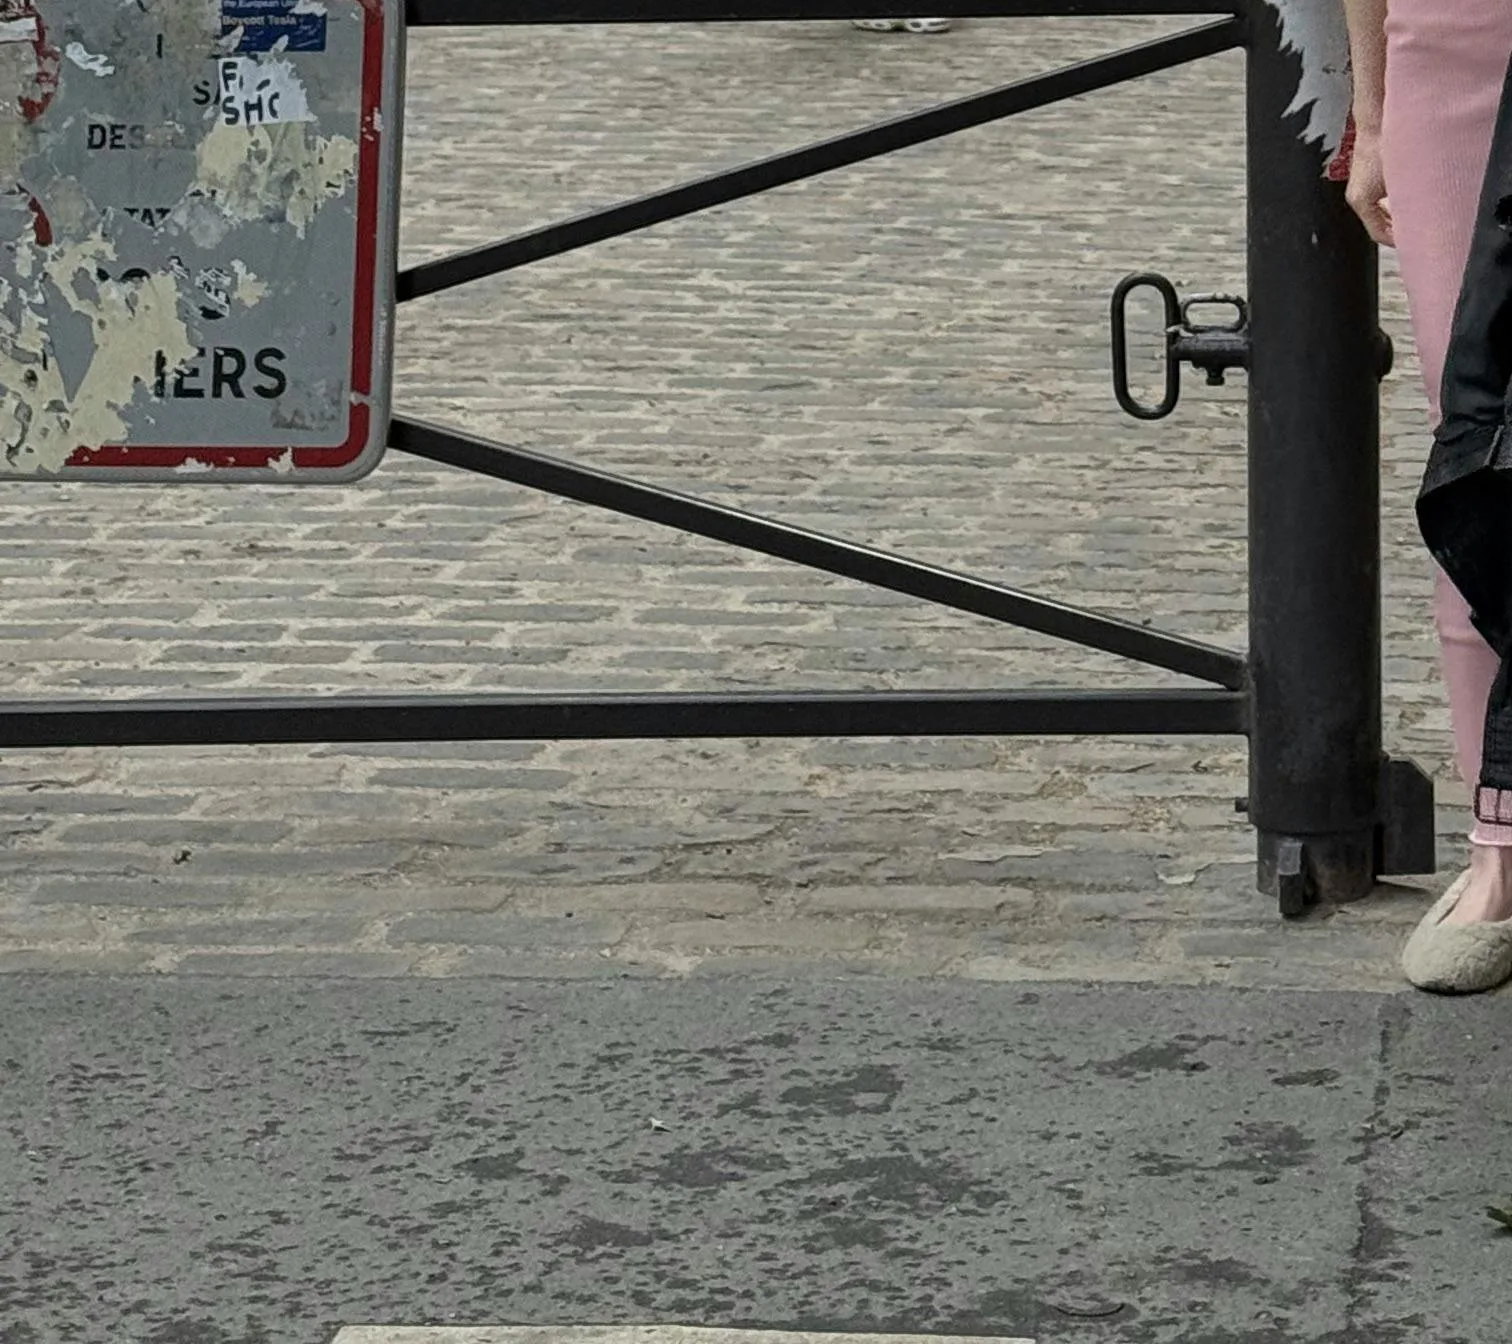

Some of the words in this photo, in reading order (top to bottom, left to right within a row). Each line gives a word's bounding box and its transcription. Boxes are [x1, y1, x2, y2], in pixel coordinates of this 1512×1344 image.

[222, 15, 265, 26] Boycott
[267, 14, 297, 26] Tesla
[153, 346, 287, 400] IERS
